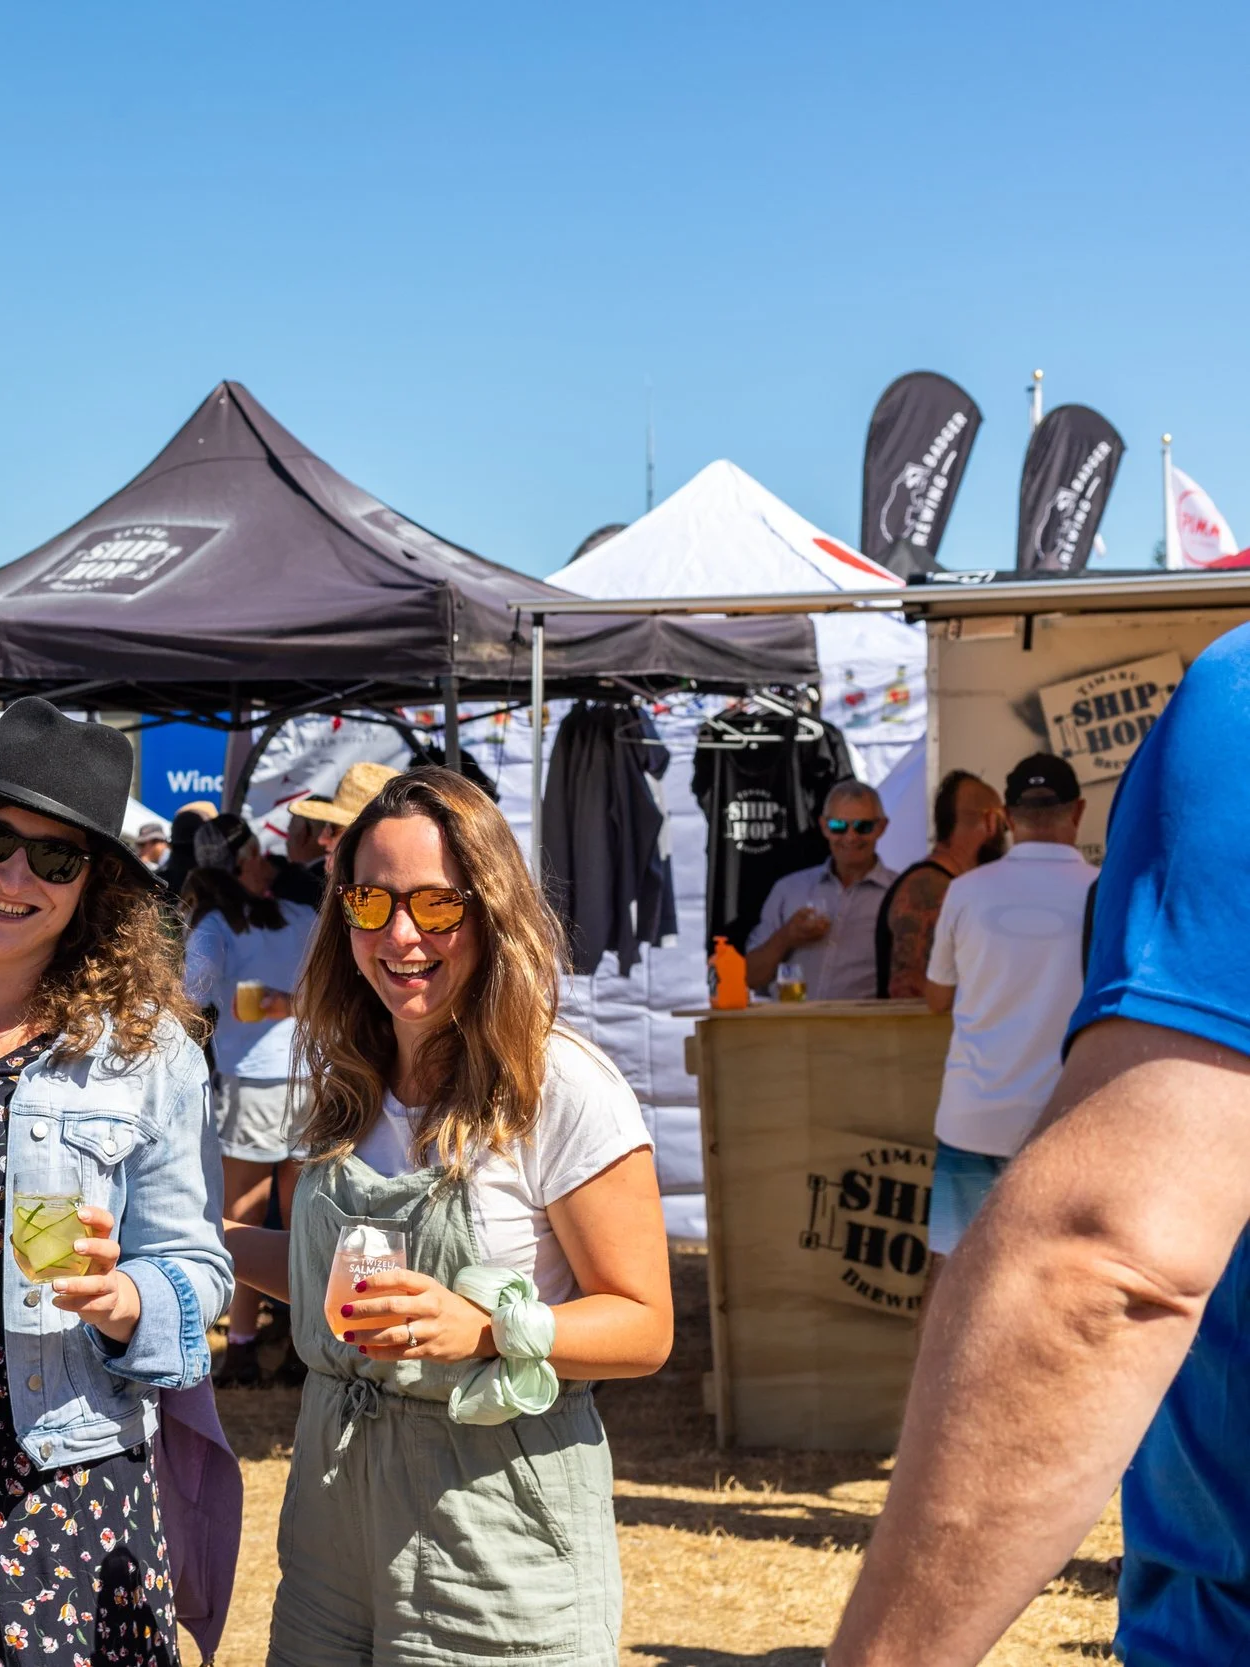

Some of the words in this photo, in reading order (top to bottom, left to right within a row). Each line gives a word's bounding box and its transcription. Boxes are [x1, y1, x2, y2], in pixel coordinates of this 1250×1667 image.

[922, 411, 967, 469] BADGER
[911, 474, 948, 547] REWING
[81, 540, 169, 561] SHIP
[59, 561, 138, 579] HOP
[1072, 681, 1158, 727] SHIP
[728, 801, 779, 820] SHIP
[733, 822, 776, 840] HOP
[860, 1149, 934, 1169] TIMA
[839, 1169, 932, 1225] SHI
[843, 1221, 927, 1276] HO
[361, 1257, 392, 1268] TWIZEL
